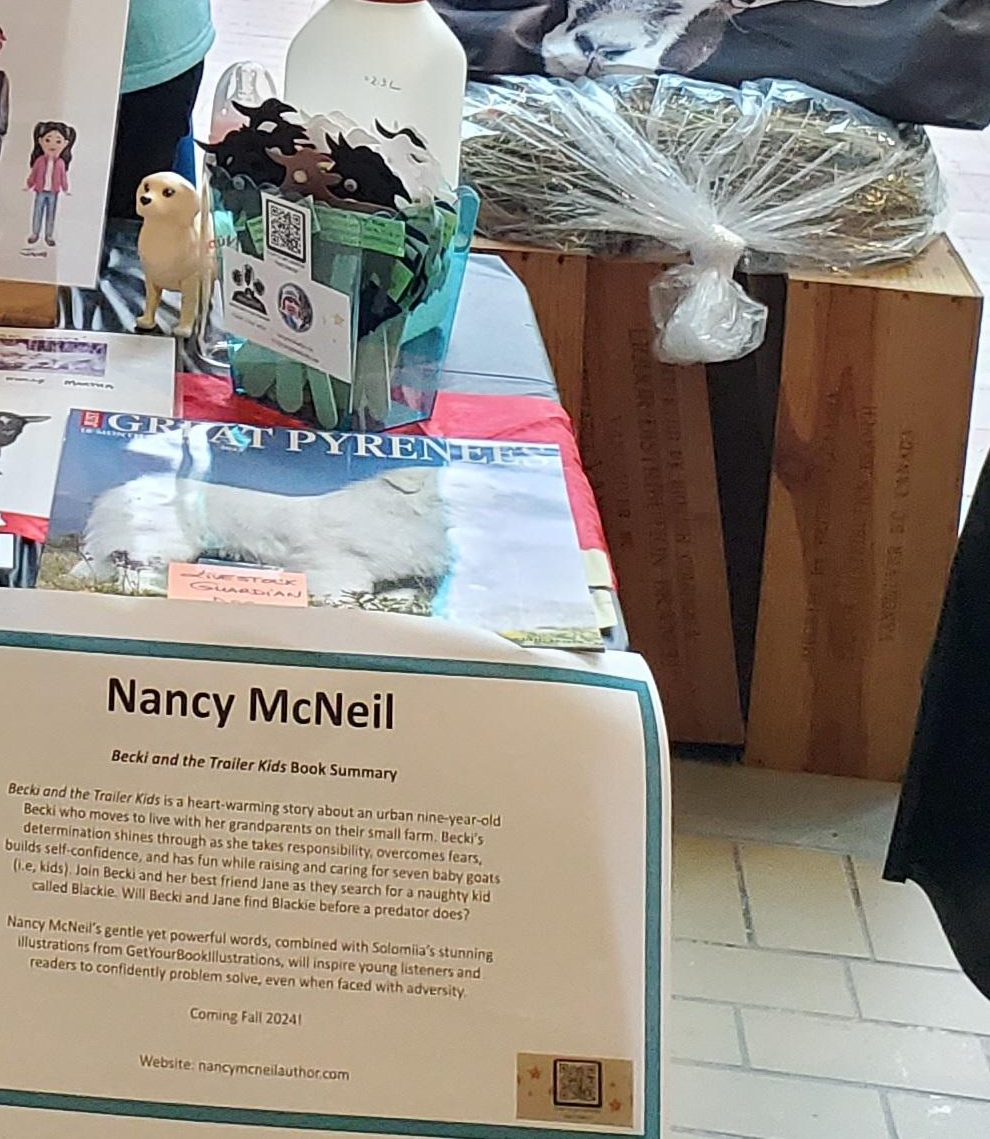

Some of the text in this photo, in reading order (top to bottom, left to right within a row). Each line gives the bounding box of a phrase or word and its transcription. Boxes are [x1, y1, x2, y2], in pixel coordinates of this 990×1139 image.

[180, 569, 298, 587] LIVESTOCK
[189, 581, 303, 600] GUARDIAN
[108, 677, 394, 730] Nancy McNeil
[111, 749, 398, 783] Becki and the Trailer Kids Book Summary
[8, 782, 501, 827] Becki and the Trailer Kids is a heart-warming story about an urban nine-year-old
[24, 802, 56, 817] Becki
[59, 806, 87, 819] who
[89, 810, 130, 823] moves
[133, 812, 146, 824] to
[149, 812, 171, 826] live
[174, 815, 202, 828] with
[205, 816, 226, 830] her
[229, 819, 312, 835] grandparents
[315, 825, 332, 836] on
[335, 824, 365, 838] their
[368, 827, 401, 840] small
[441, 831, 484, 846] Becki's
[190, 1007, 238, 1025] Coming
[241, 1010, 263, 1024] Fall
[198, 1061, 350, 1081] nancymcneilauthor.com
